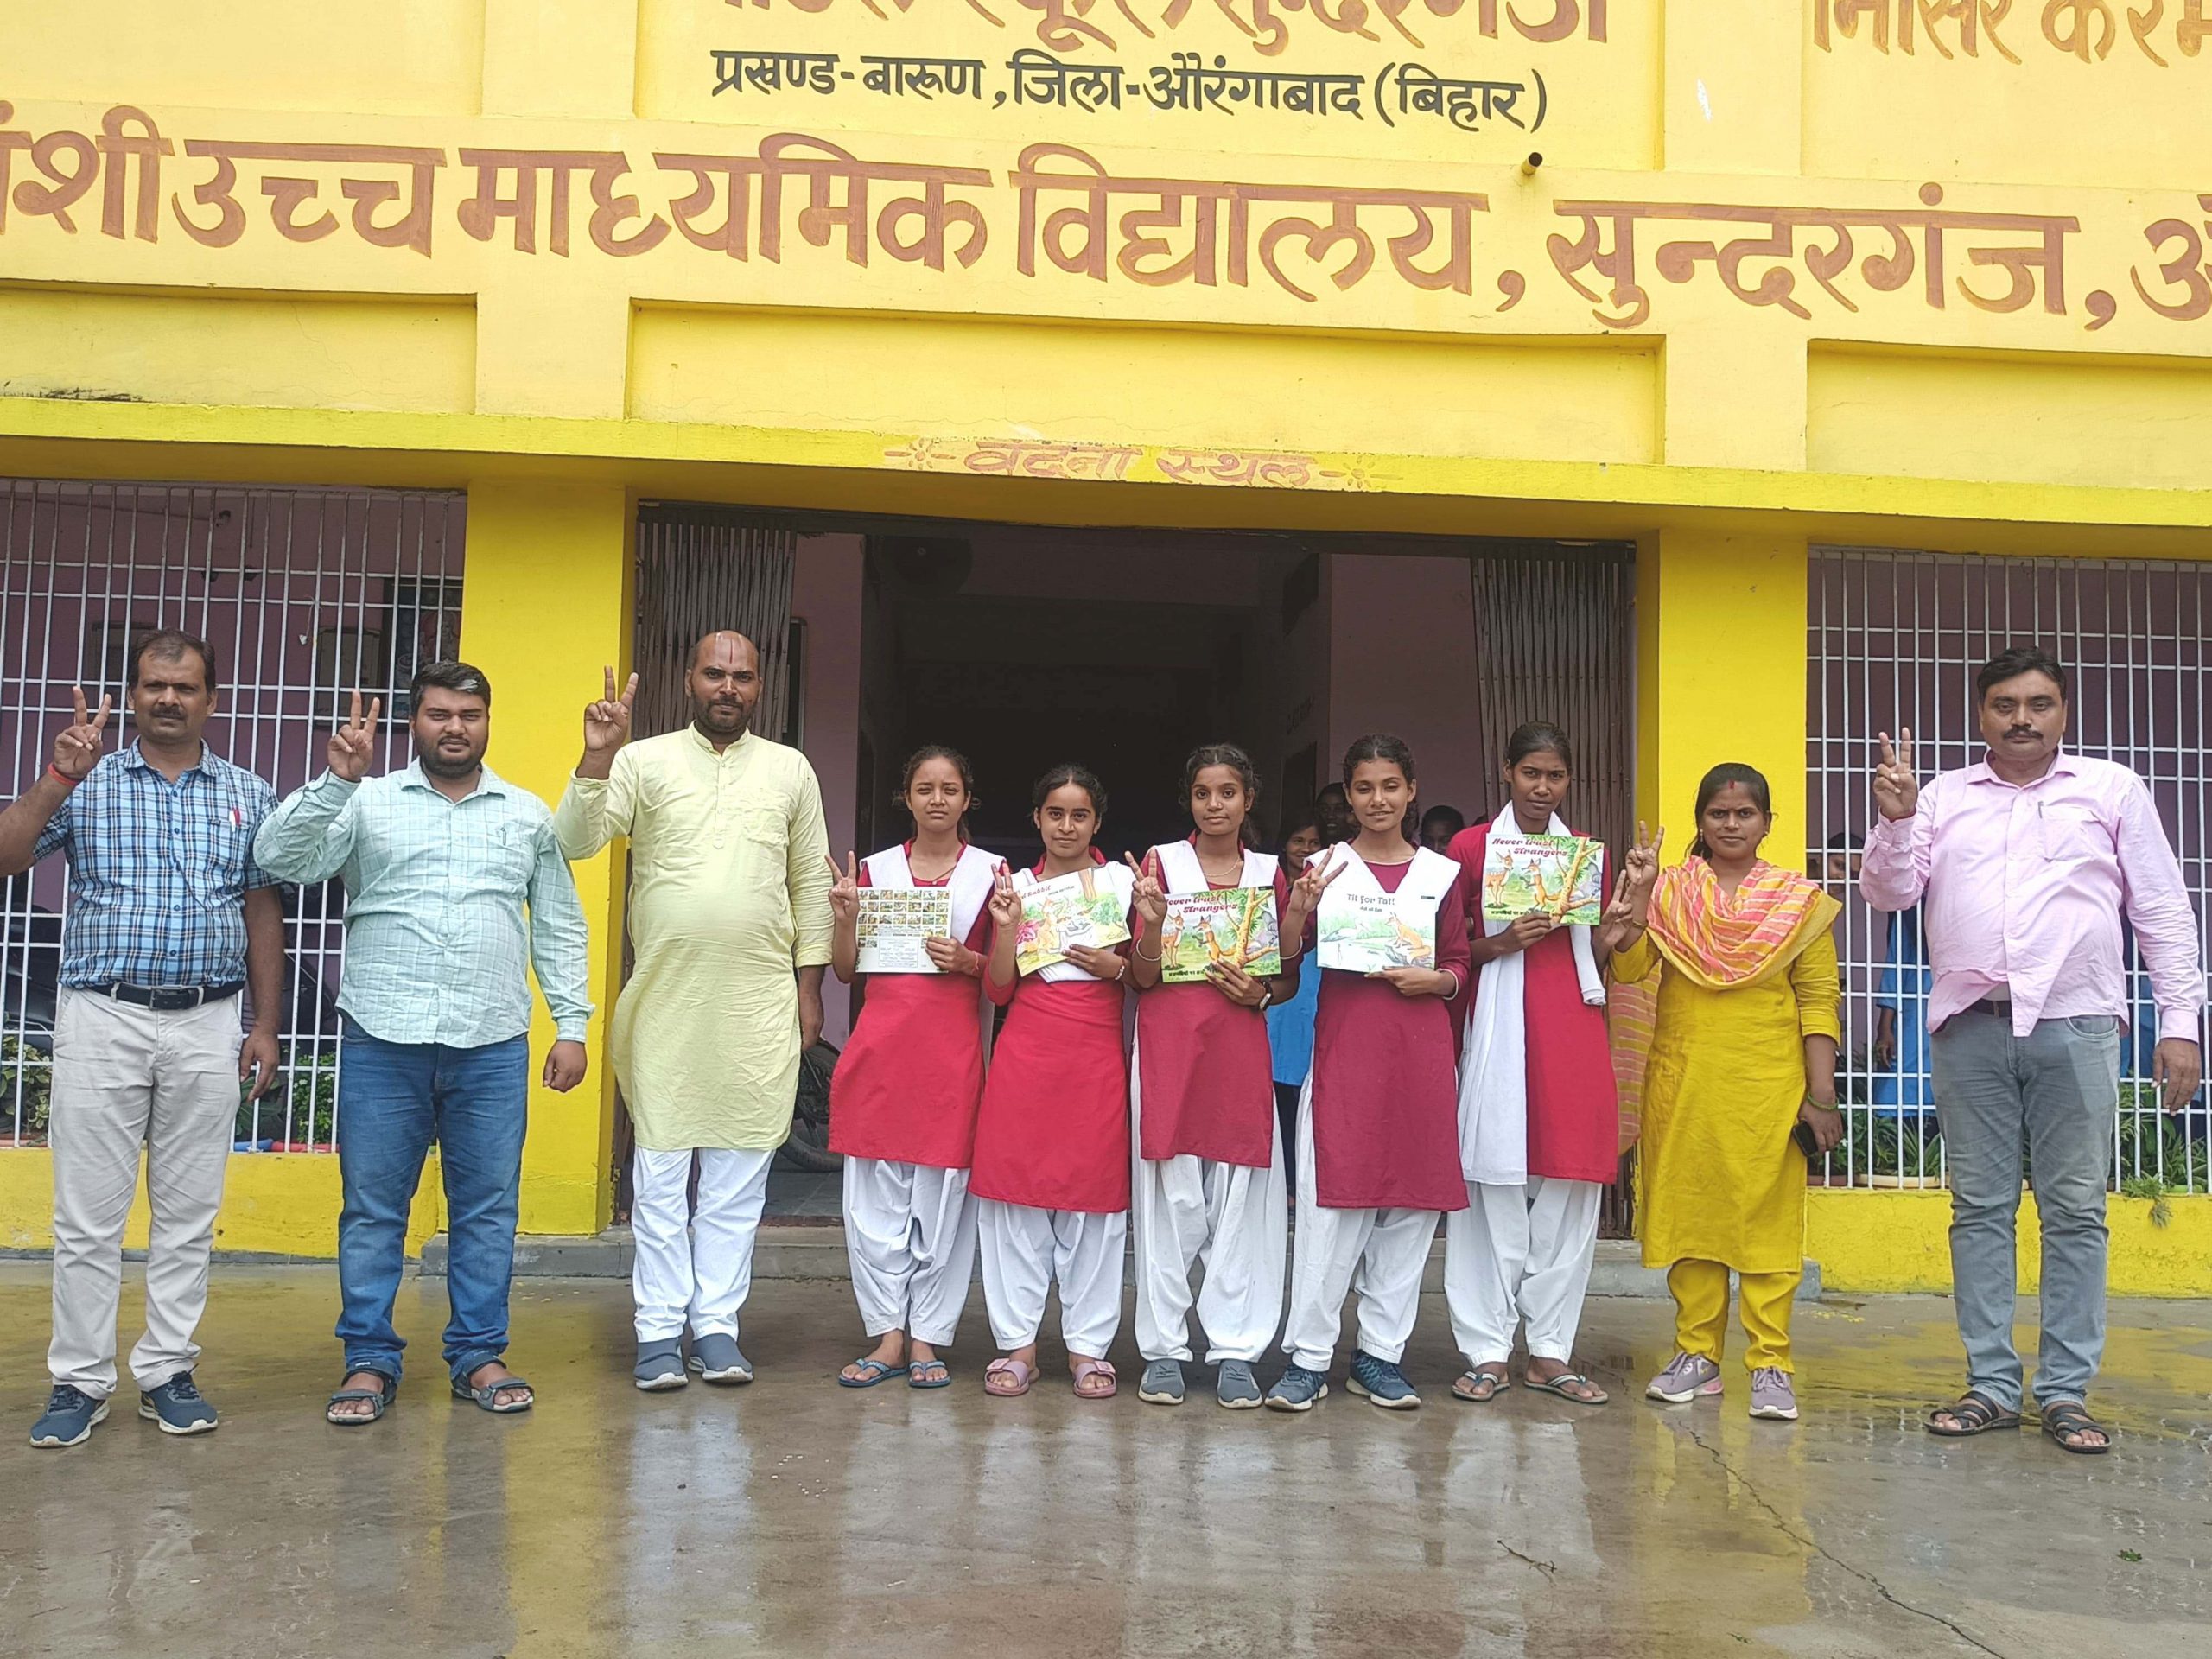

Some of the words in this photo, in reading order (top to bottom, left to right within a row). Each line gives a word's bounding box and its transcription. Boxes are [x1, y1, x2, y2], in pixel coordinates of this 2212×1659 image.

[1374, 62, 1548, 133] (बिहार)
[172, 138, 448, 258] उच्च
[457, 132, 994, 271] माध्यमिक
[1156, 448, 1314, 488] स्थल
